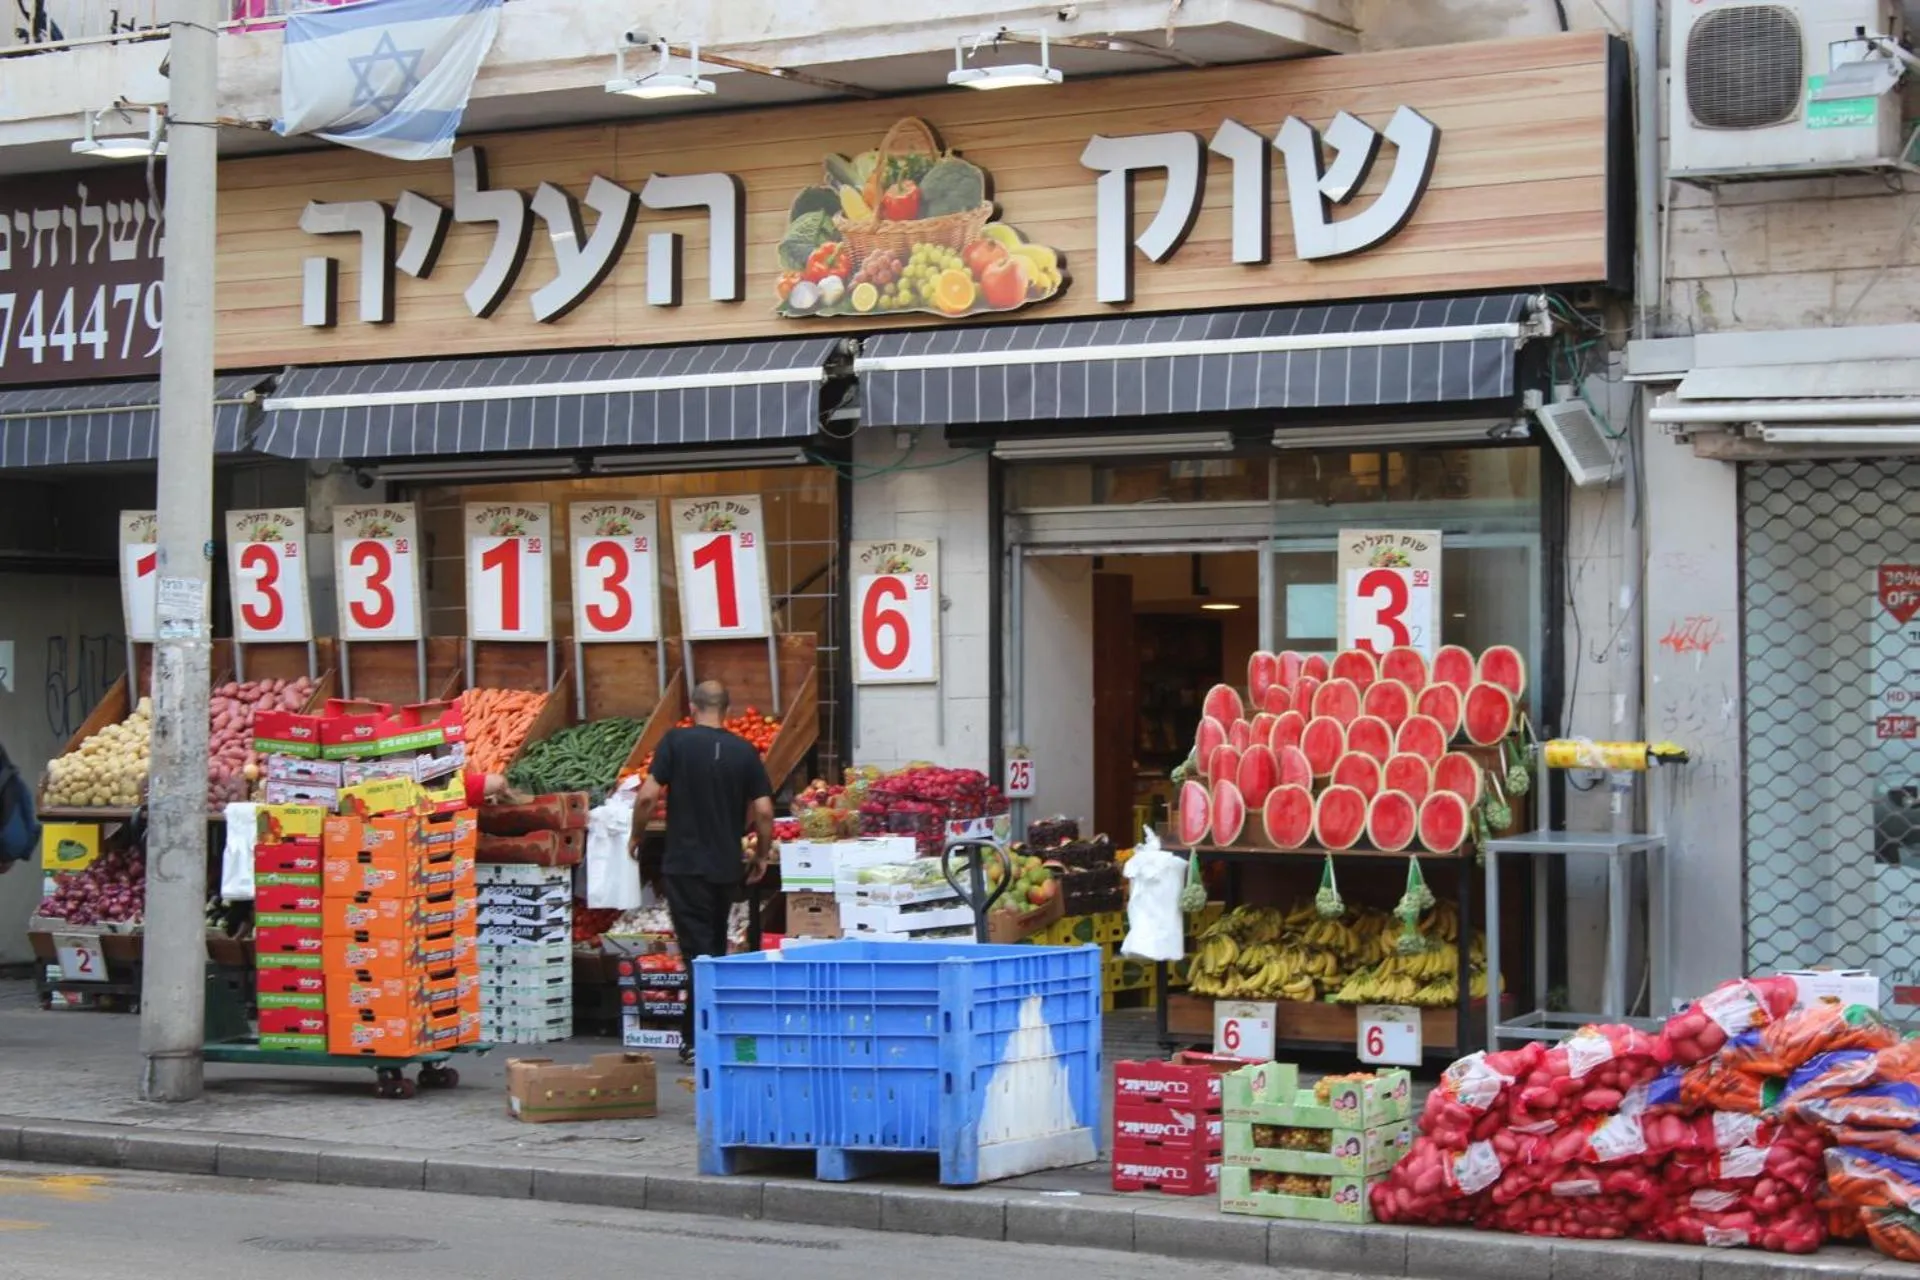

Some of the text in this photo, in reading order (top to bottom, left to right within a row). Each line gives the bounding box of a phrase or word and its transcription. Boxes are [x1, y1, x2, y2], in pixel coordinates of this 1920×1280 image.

[298, 105, 1441, 328] שוק העליה
[235, 512, 296, 531] שוק העליה
[343, 507, 406, 527] שוק העליה
[475, 505, 541, 524] שוק העליה
[580, 505, 646, 524] שוק העליה
[682, 500, 750, 522] שוק העליה
[859, 542, 928, 563] שוק העליה
[1350, 533, 1429, 555] שוק העליה
[240, 543, 284, 632] 3
[350, 540, 395, 629] 3
[482, 538, 520, 630] 1
[585, 540, 632, 632] 3
[693, 534, 739, 628] 1
[862, 576, 911, 670] 6
[1354, 569, 1411, 659] 3
[1010, 762, 1030, 790] 25
[76, 948, 92, 973] 2
[1224, 1019, 1240, 1050] 6
[1366, 1025, 1384, 1056] 6
